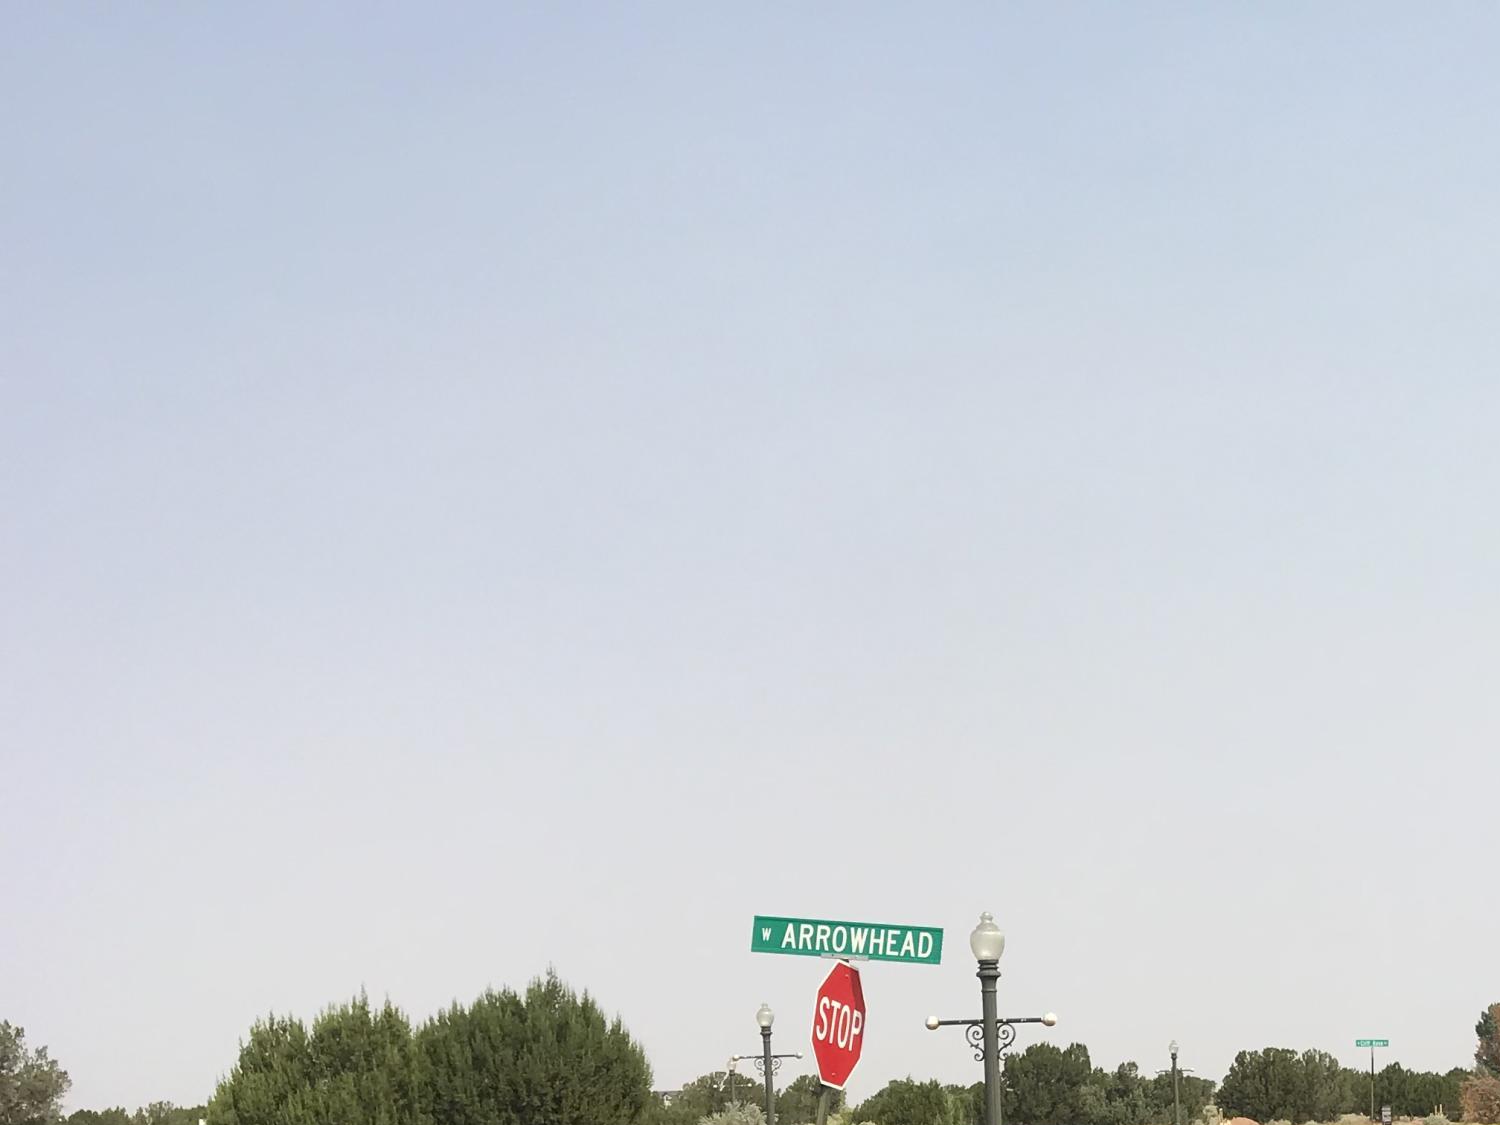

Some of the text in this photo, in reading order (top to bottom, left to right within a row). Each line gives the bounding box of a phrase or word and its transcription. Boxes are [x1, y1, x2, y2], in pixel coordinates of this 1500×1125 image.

[762, 923, 933, 959] W ARROWHEAD
[816, 996, 863, 1051] STOP
